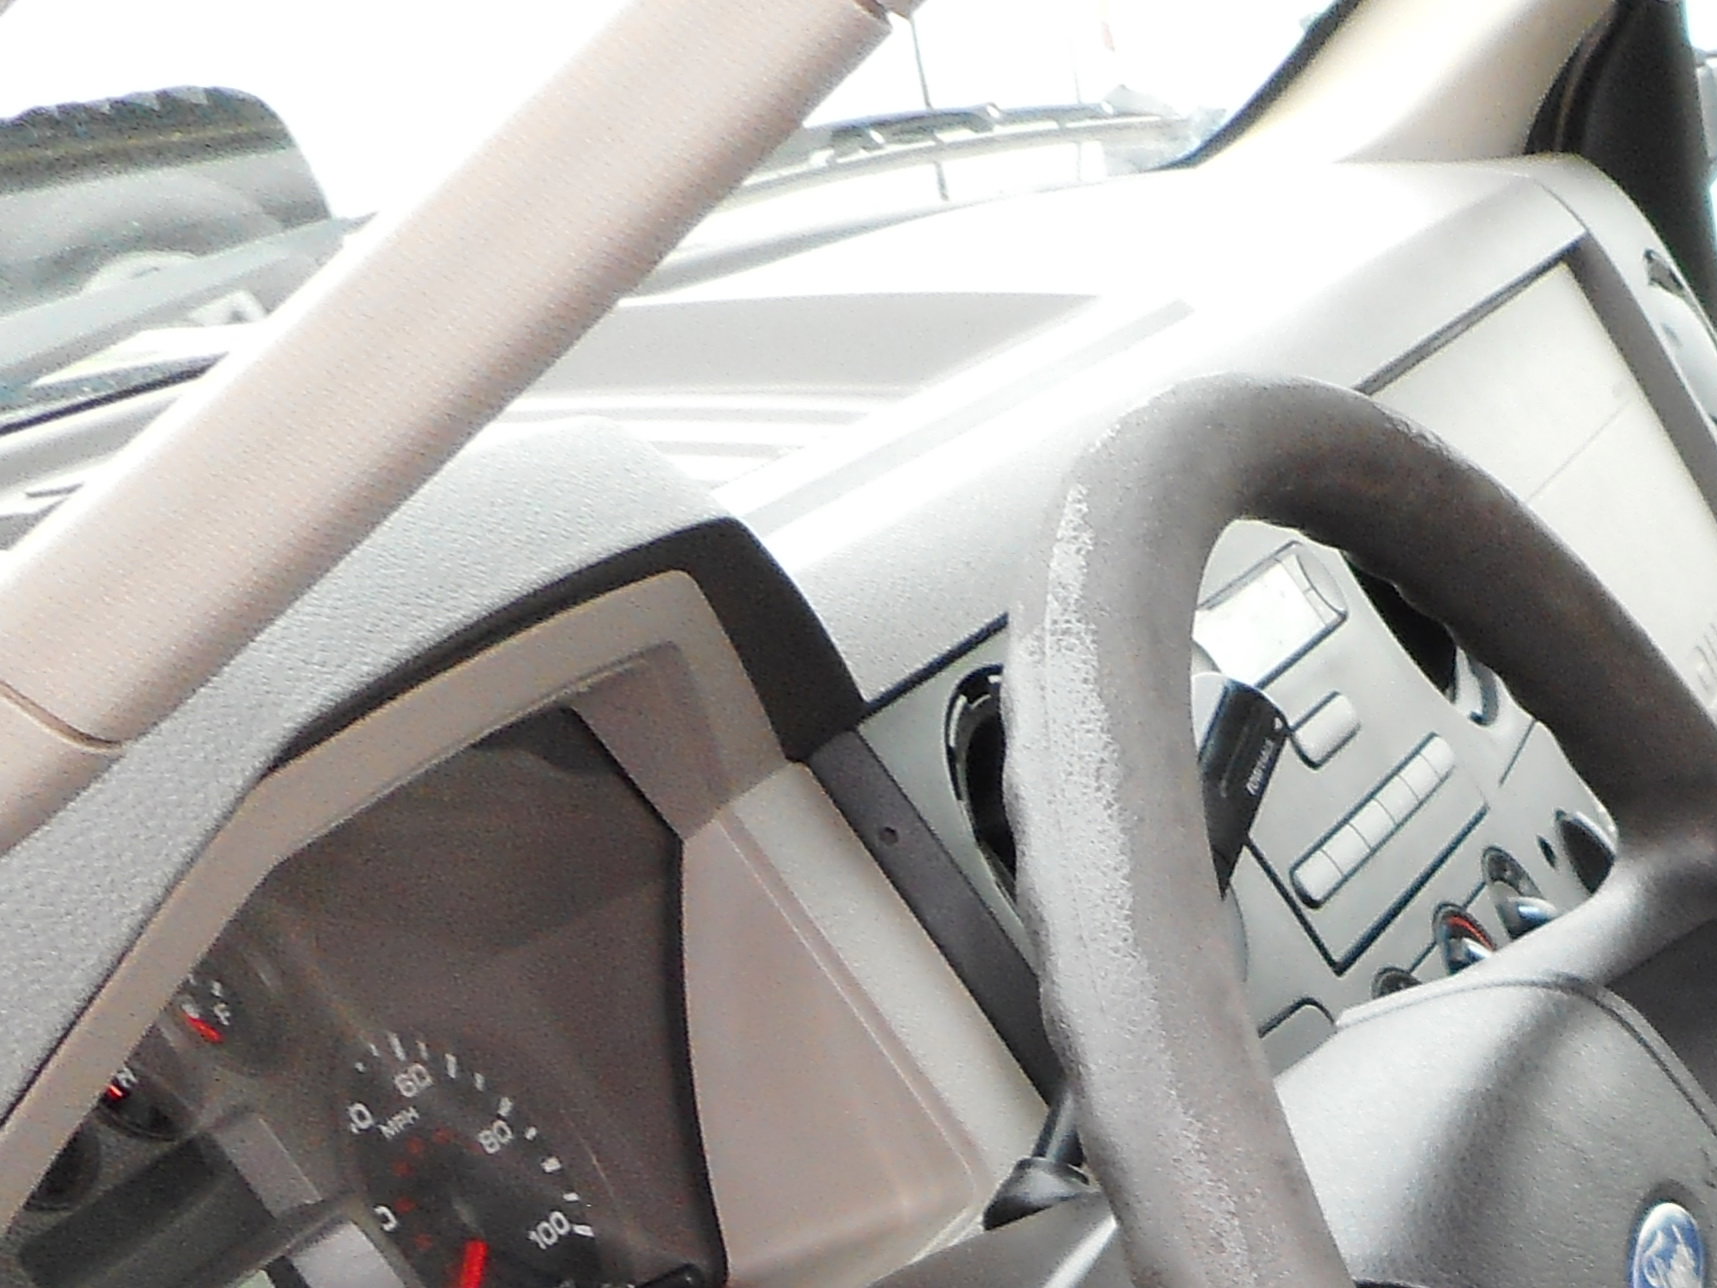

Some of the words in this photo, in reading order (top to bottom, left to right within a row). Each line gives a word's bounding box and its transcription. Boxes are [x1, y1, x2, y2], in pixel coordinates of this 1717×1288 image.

[394, 1062, 432, 1098] 60
[377, 1106, 419, 1140] MPH
[478, 1119, 513, 1154] 80
[528, 1210, 570, 1250] 100
